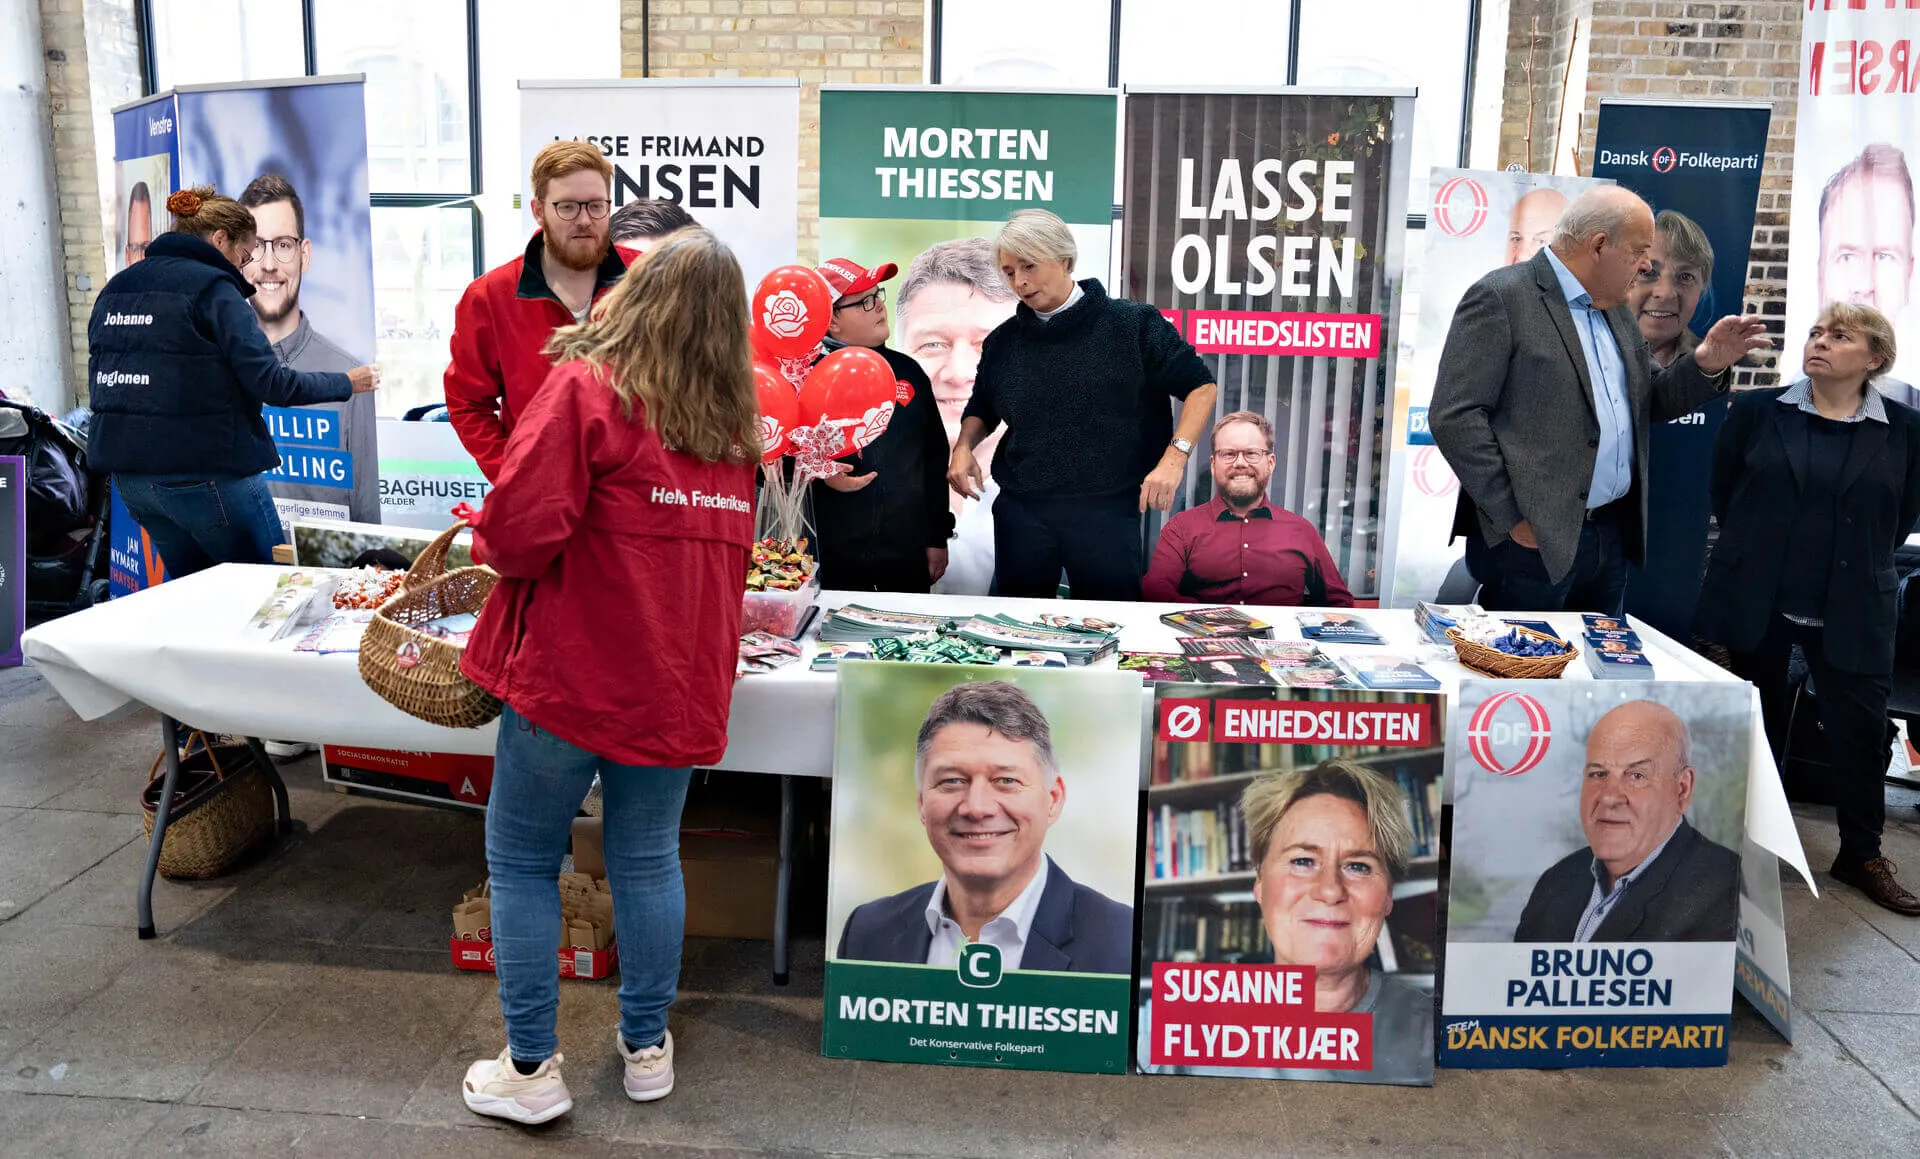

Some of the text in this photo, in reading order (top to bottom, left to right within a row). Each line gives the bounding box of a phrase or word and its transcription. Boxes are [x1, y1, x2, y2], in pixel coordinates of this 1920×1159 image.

[149, 117, 172, 137] Venstre
[641, 136, 765, 157] FRIMAND
[884, 127, 1048, 161] MORTEN
[1600, 150, 1758, 171] Dansk DF Folkeparti
[614, 164, 760, 208] NSEN
[876, 167, 1054, 202] THIESSEN
[1180, 158, 1355, 222] LASSE
[1171, 233, 1356, 297] OLSEN
[104, 312, 153, 327] Johanne
[1196, 318, 1373, 349] ENHEDSLISTEN
[96, 371, 150, 386] Regionen
[262, 414, 330, 440] ILLIP
[379, 479, 489, 498] BAGHUSET
[691, 489, 751, 514] Frederiksen
[276, 503, 345, 520] rgerlige stemme
[127, 535, 139, 555] JAN
[1167, 704, 1420, 741] Ø ENHEDSLISTEN
[1490, 720, 1528, 746] DF
[337, 749, 409, 767] SOCIALDEMOKRATIET
[460, 776, 478, 797] A
[968, 952, 991, 978] C
[1531, 949, 1653, 977] BRUNO
[1163, 968, 1303, 1005] SUSANNE
[1507, 979, 1672, 1007] PALLESEN
[839, 995, 1119, 1035] MORTEN THIESSEN
[1446, 1019, 1480, 1034] STEM
[909, 1036, 1044, 1054] Det Konservative Folkeparti
[1164, 1023, 1361, 1062] FLYDTKJÆR
[1447, 1025, 1724, 1051] DANSK FOLKEPARTI
